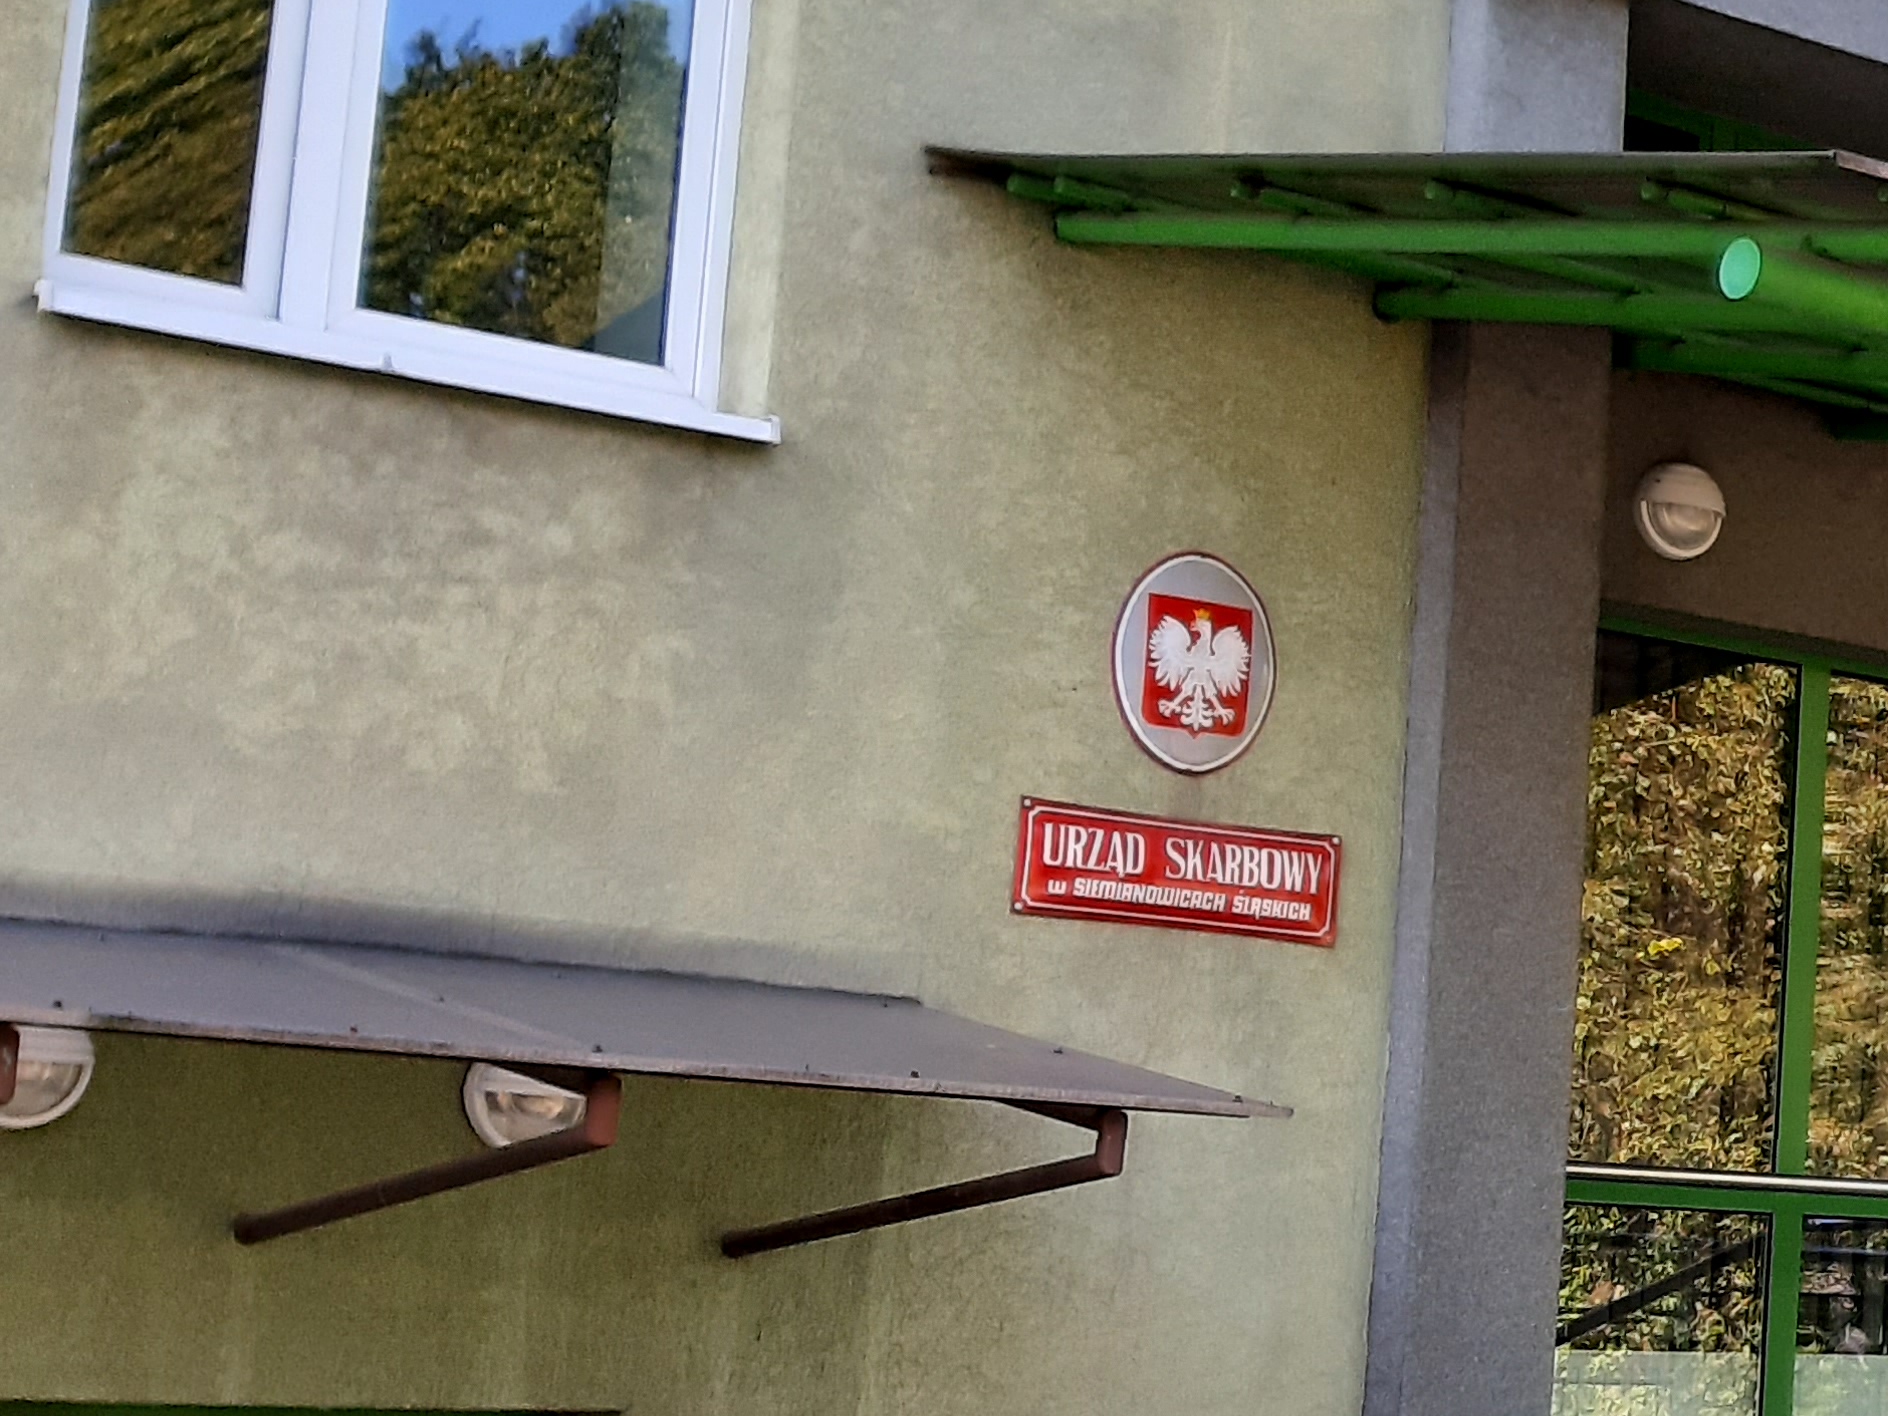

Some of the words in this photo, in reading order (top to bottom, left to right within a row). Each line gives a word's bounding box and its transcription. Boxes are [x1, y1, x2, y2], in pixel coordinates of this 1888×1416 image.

[1042, 822, 1146, 879] URZĄD
[1164, 836, 1323, 895] SKARBOWY
[1072, 876, 1226, 914] SIEMIANOWICACH
